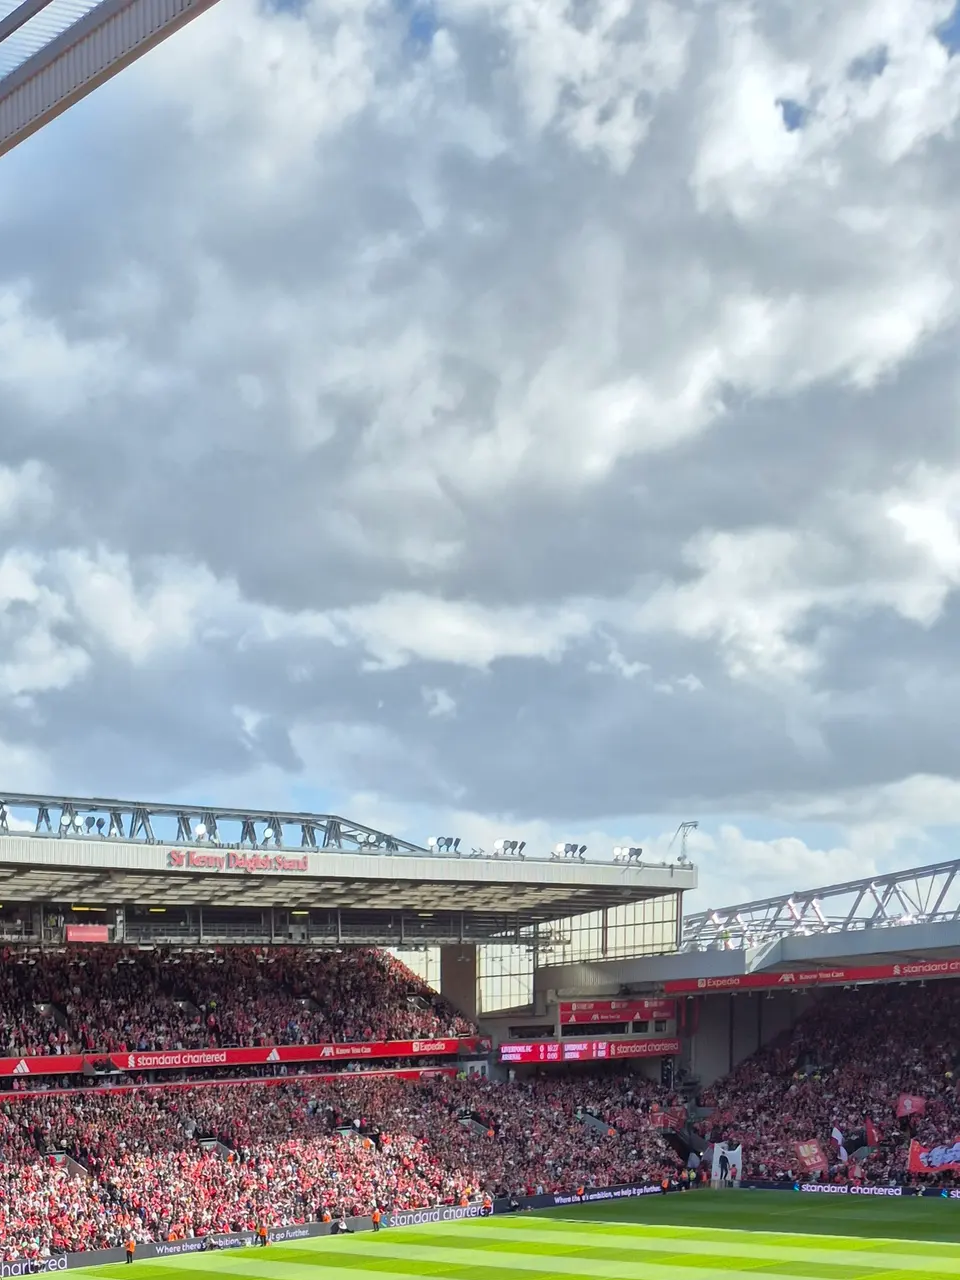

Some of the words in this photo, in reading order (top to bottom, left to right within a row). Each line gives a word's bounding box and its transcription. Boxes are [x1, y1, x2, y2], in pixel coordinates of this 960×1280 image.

[169, 850, 185, 866] Sir
[188, 851, 225, 871] Kenny
[228, 852, 272, 873] Dalglish
[275, 855, 308, 871] Stand
[903, 962, 948, 974] standard
[707, 978, 740, 988] Expedia
[778, 974, 795, 982] AXA
[320, 1046, 334, 1056] AXA
[420, 1042, 446, 1052] Expedia
[617, 1044, 646, 1054] standard
[648, 1042, 678, 1052] chartered
[137, 1053, 180, 1067] standard
[182, 1051, 226, 1064] chartered
[801, 1183, 848, 1193] standard
[850, 1184, 902, 1196] chartered
[554, 1196, 571, 1204] Where
[390, 1210, 440, 1227] standard
[155, 1243, 181, 1254] Where
[182, 1240, 206, 1252] there's
[276, 1232, 285, 1241] go
[285, 1228, 310, 1239] further.
